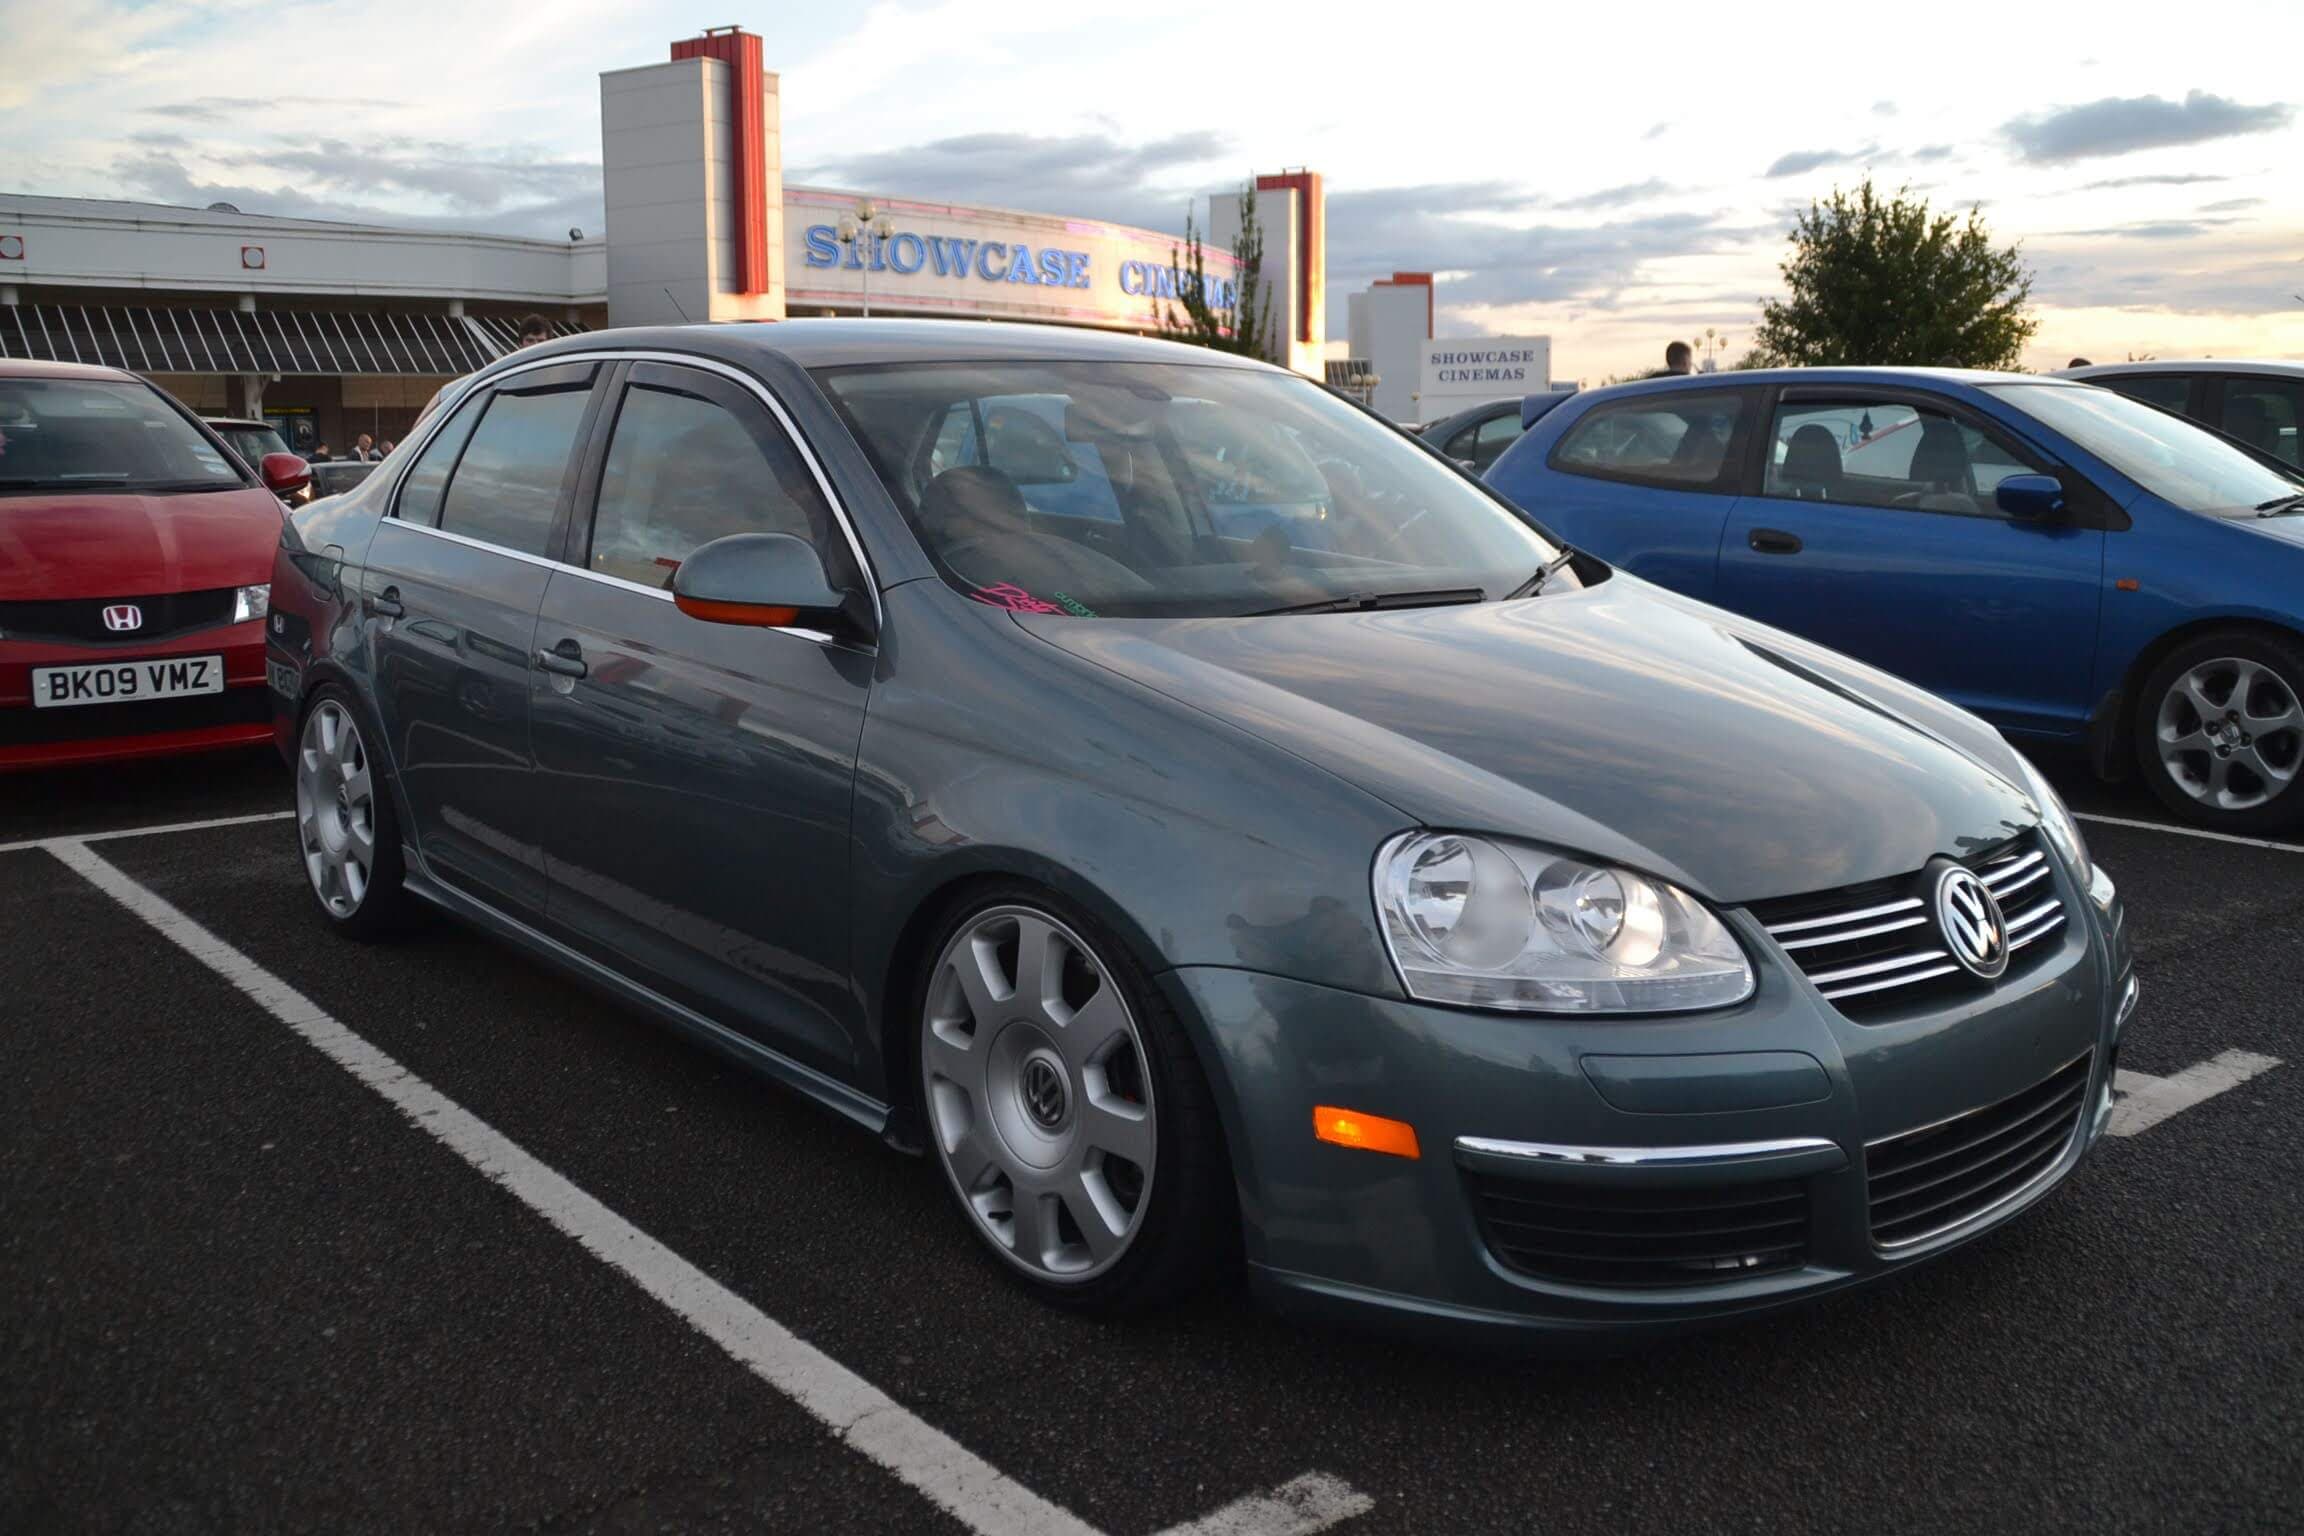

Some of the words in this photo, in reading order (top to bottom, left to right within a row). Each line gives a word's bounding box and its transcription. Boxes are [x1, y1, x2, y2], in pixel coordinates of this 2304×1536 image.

[804, 224, 1090, 288] SHOWCASE
[1431, 350, 1534, 365] SHOWCASE
[1438, 367, 1524, 382] CINEMAS
[48, 667, 138, 700] BK09
[148, 661, 209, 692] VMZ
